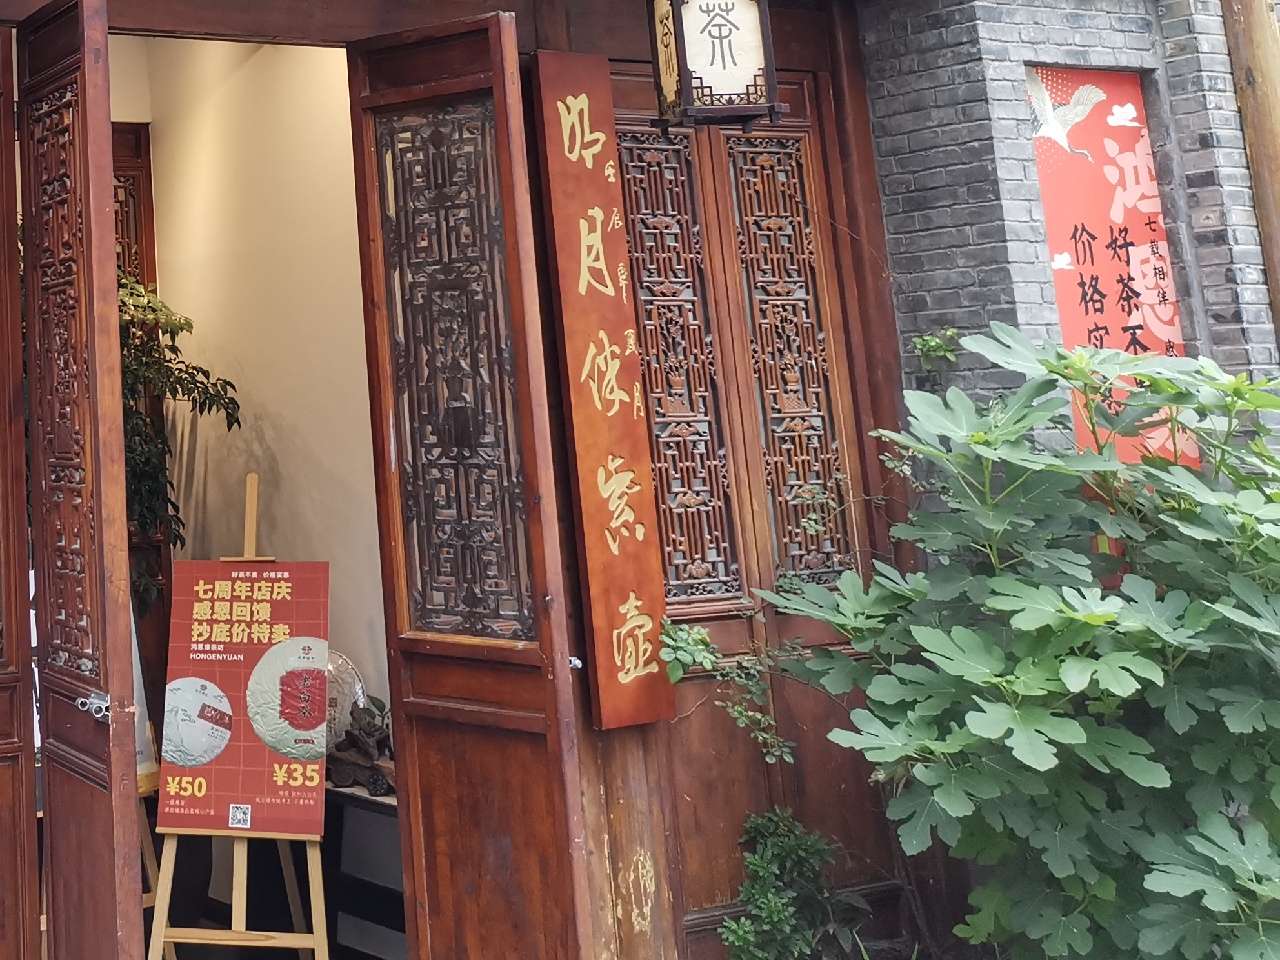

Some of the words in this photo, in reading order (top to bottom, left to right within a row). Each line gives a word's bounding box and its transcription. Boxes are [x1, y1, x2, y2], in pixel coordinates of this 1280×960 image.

[698, 1, 741, 71] 茶
[1144, 215, 1170, 308] 七载相伴
[193, 580, 292, 600] 七周年店庆
[192, 600, 272, 621] 感恩回馈
[191, 621, 290, 644] 抄底价特卖
[189, 652, 244, 661] HONGENYUAN
[273, 763, 320, 787] ¥35
[166, 776, 207, 798] ¥50
